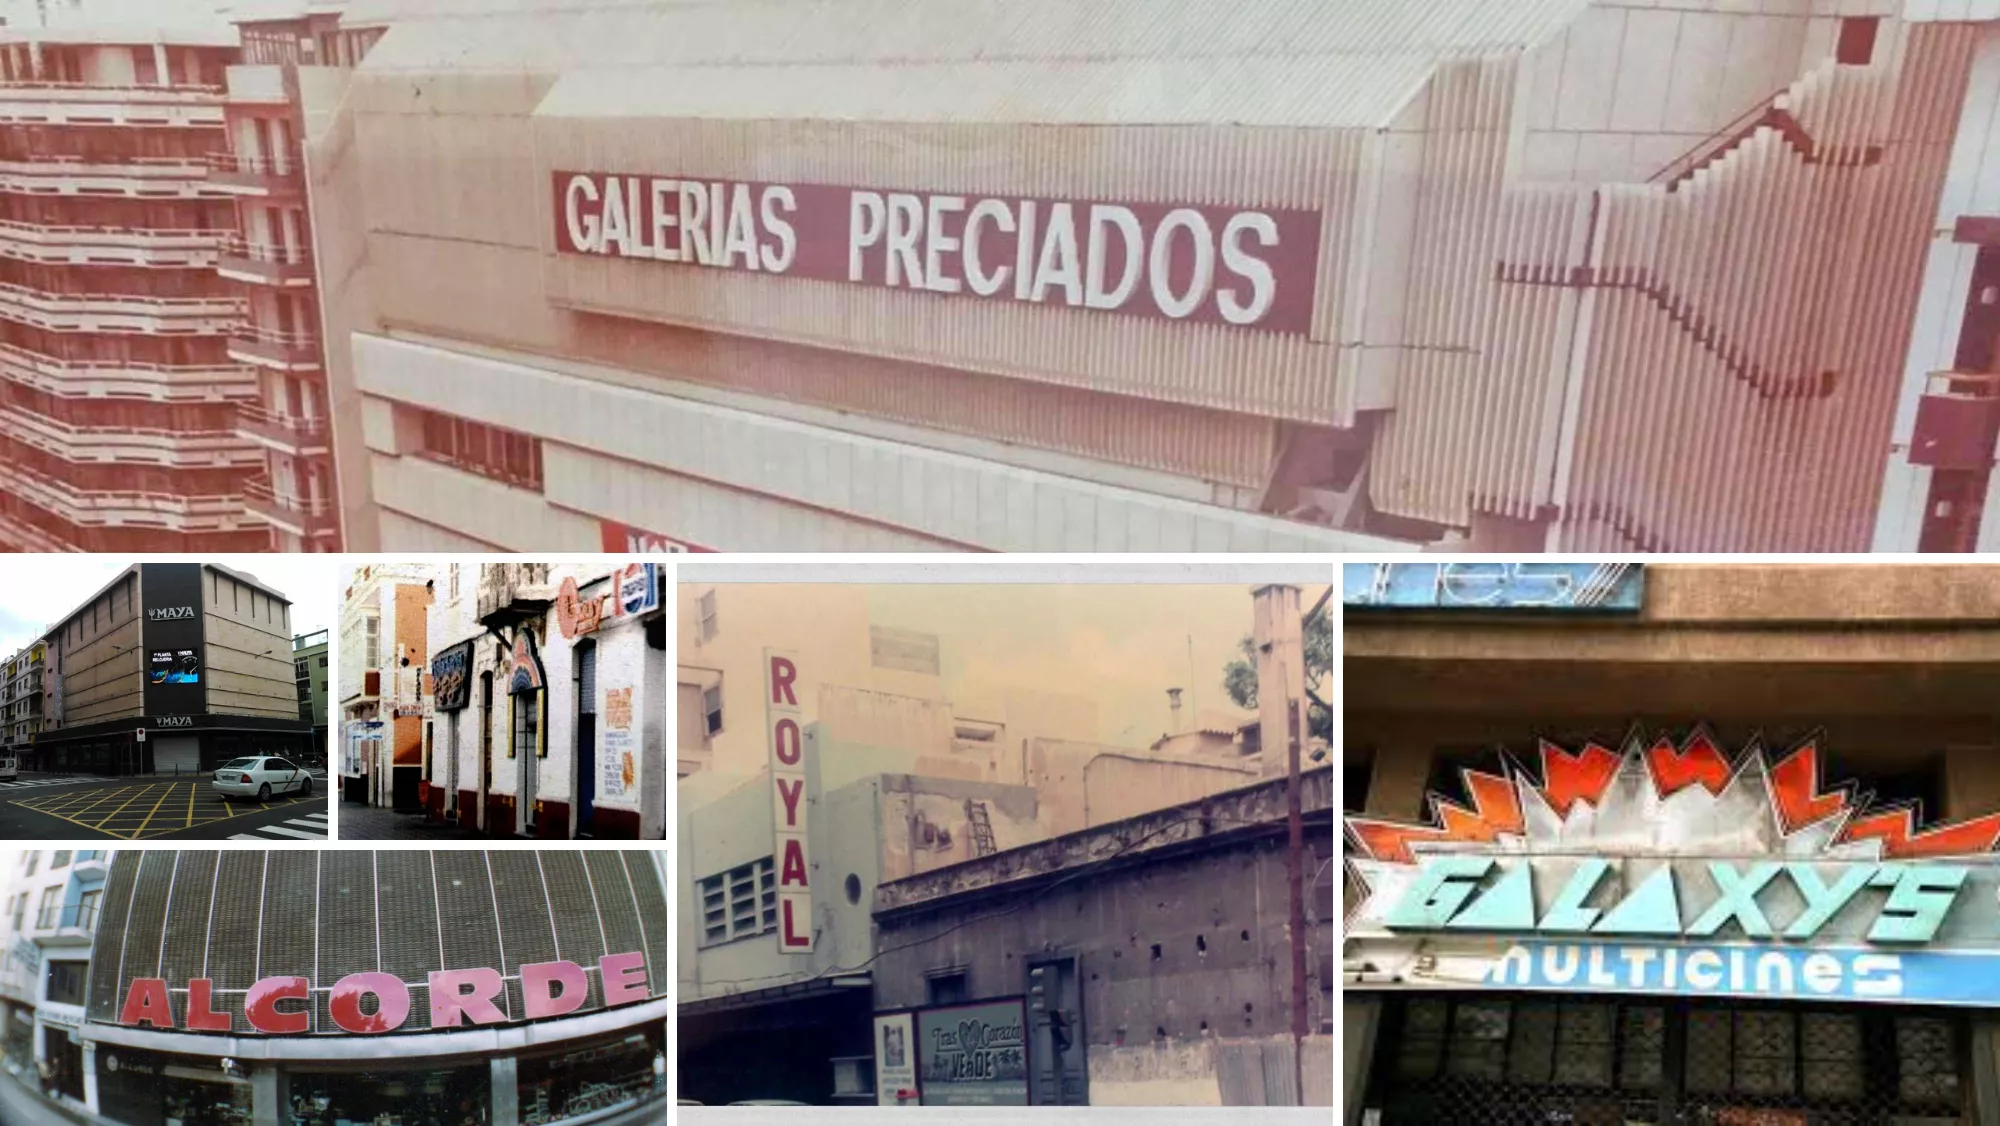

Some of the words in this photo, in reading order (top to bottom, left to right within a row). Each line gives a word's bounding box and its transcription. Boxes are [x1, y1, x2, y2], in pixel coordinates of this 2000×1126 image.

[564, 174, 798, 273] GALERIAS
[848, 190, 1280, 325] PRECIADOS
[156, 606, 195, 618] MAYA
[163, 717, 193, 726] MAYA
[770, 655, 811, 948] ROYAL
[1385, 861, 1970, 944] GALAXY'S
[120, 951, 651, 1033] ALCORDE
